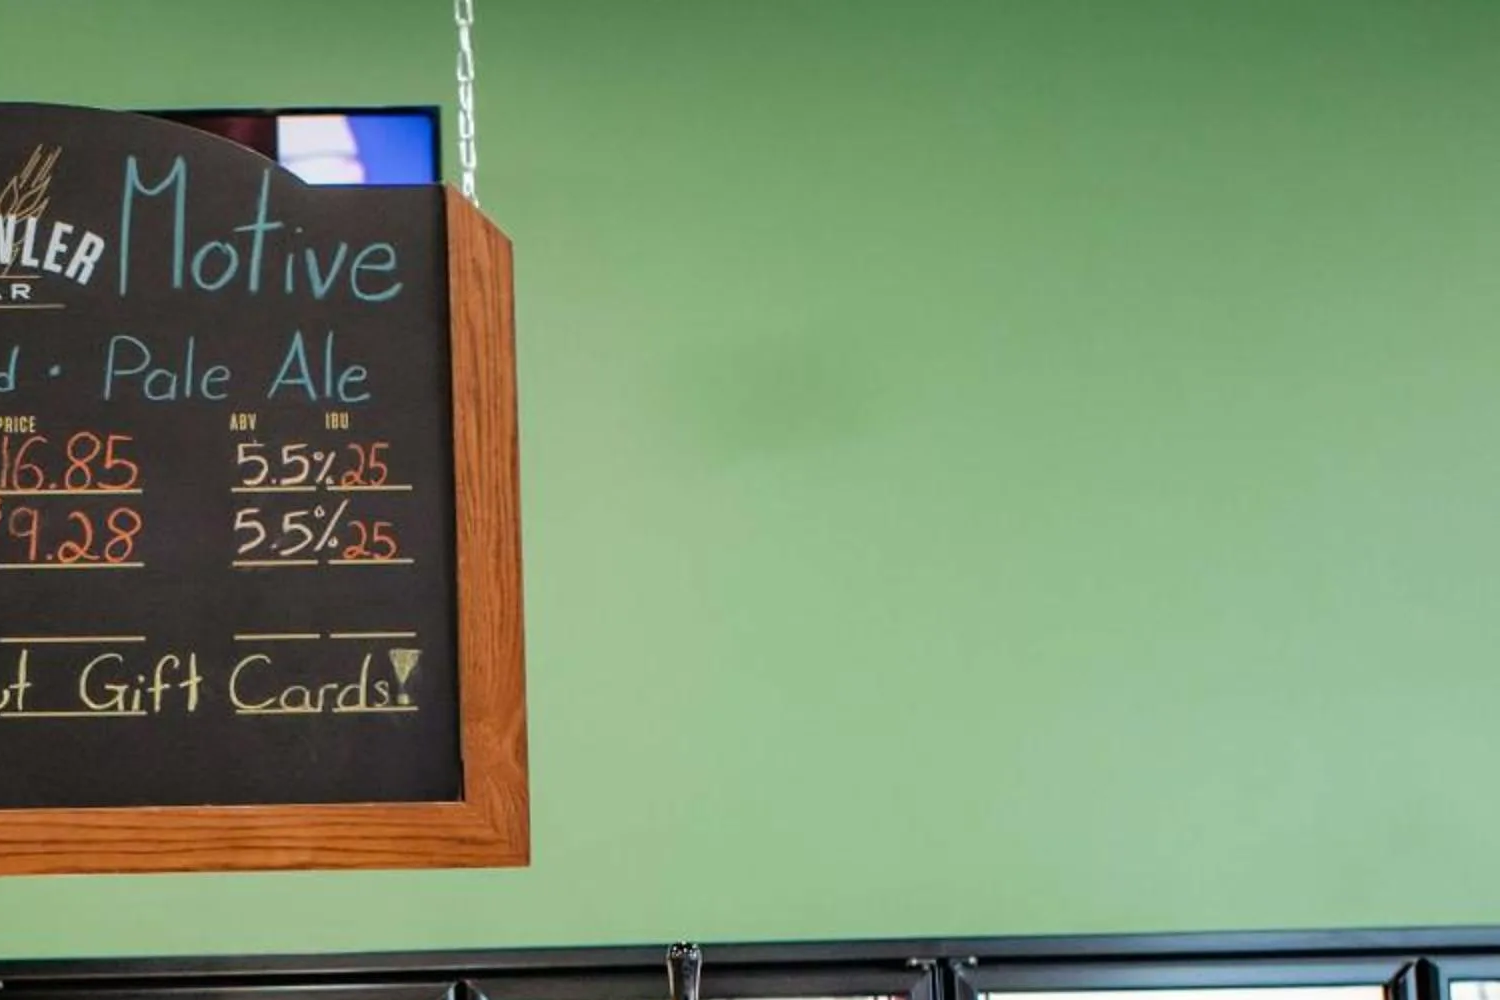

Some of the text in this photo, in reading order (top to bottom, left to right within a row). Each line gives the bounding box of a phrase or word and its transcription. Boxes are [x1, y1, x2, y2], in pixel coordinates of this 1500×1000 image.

[119, 155, 403, 301] Motive
[104, 334, 231, 400] Pale
[267, 330, 370, 401] Ale
[229, 413, 257, 432] ABV
[325, 412, 349, 430] IBU
[236, 440, 336, 487] 5.5%
[341, 441, 391, 487] 25
[233, 499, 350, 557] 5.5%
[343, 521, 398, 560] 25
[80, 652, 203, 713] Gift
